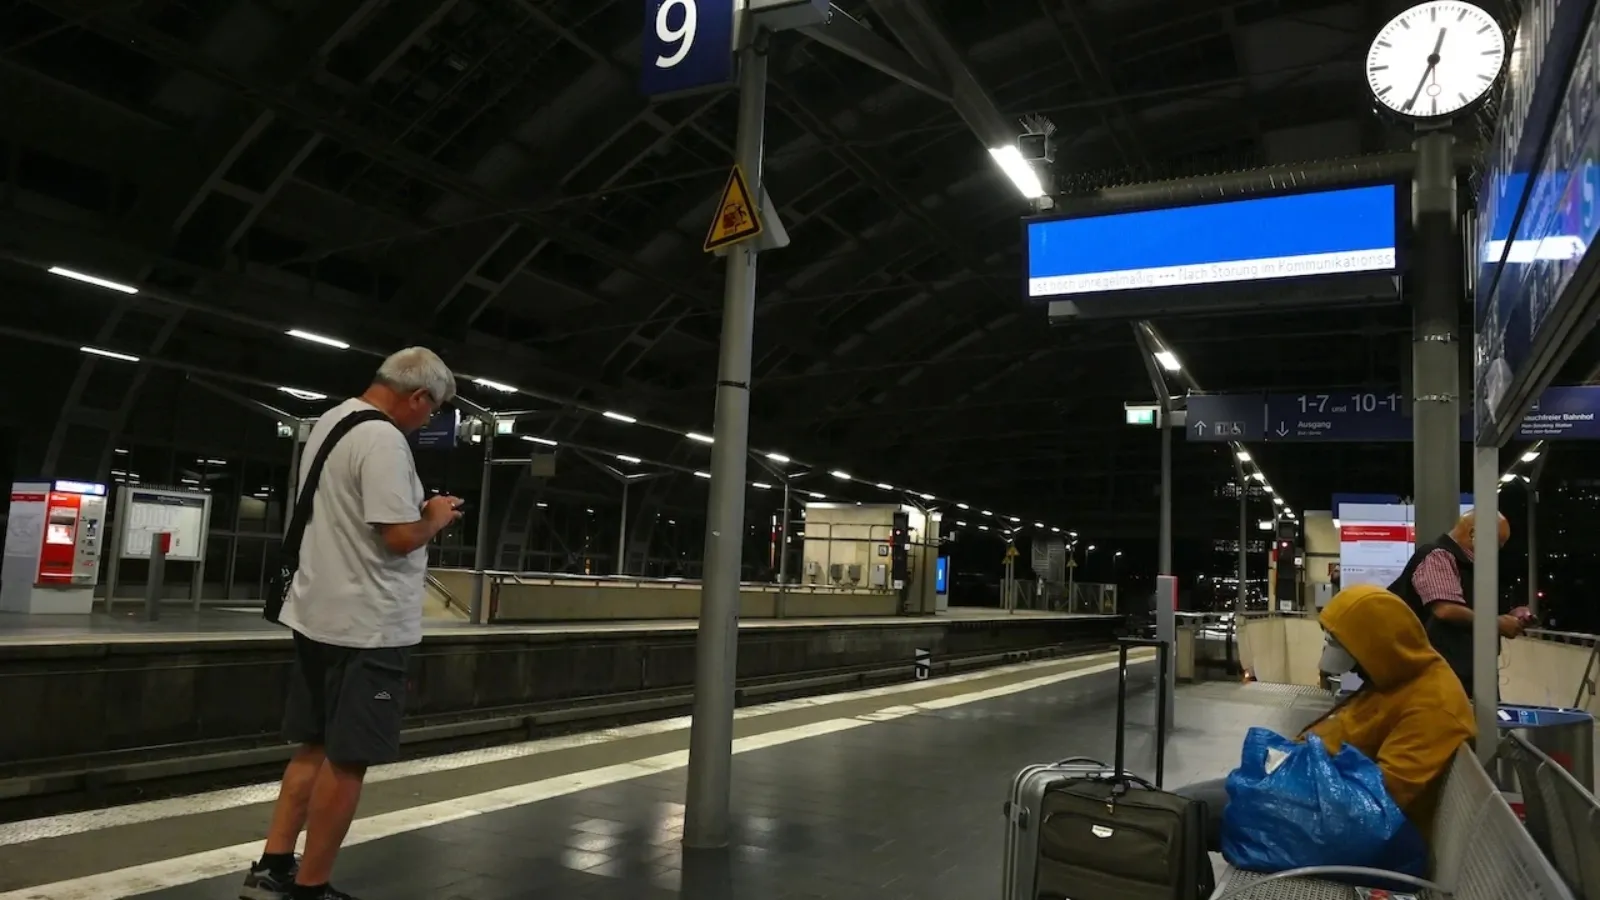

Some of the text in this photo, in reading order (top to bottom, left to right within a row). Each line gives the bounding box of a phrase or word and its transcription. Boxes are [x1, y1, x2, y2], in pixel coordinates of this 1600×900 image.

[655, 0, 698, 68] 9
[1178, 266, 1207, 281] Nach
[1262, 263, 1276, 275] im
[1278, 253, 1395, 273] Kommunikationss
[1351, 393, 1403, 412] 10-1
[1297, 420, 1332, 430] Ausgang
